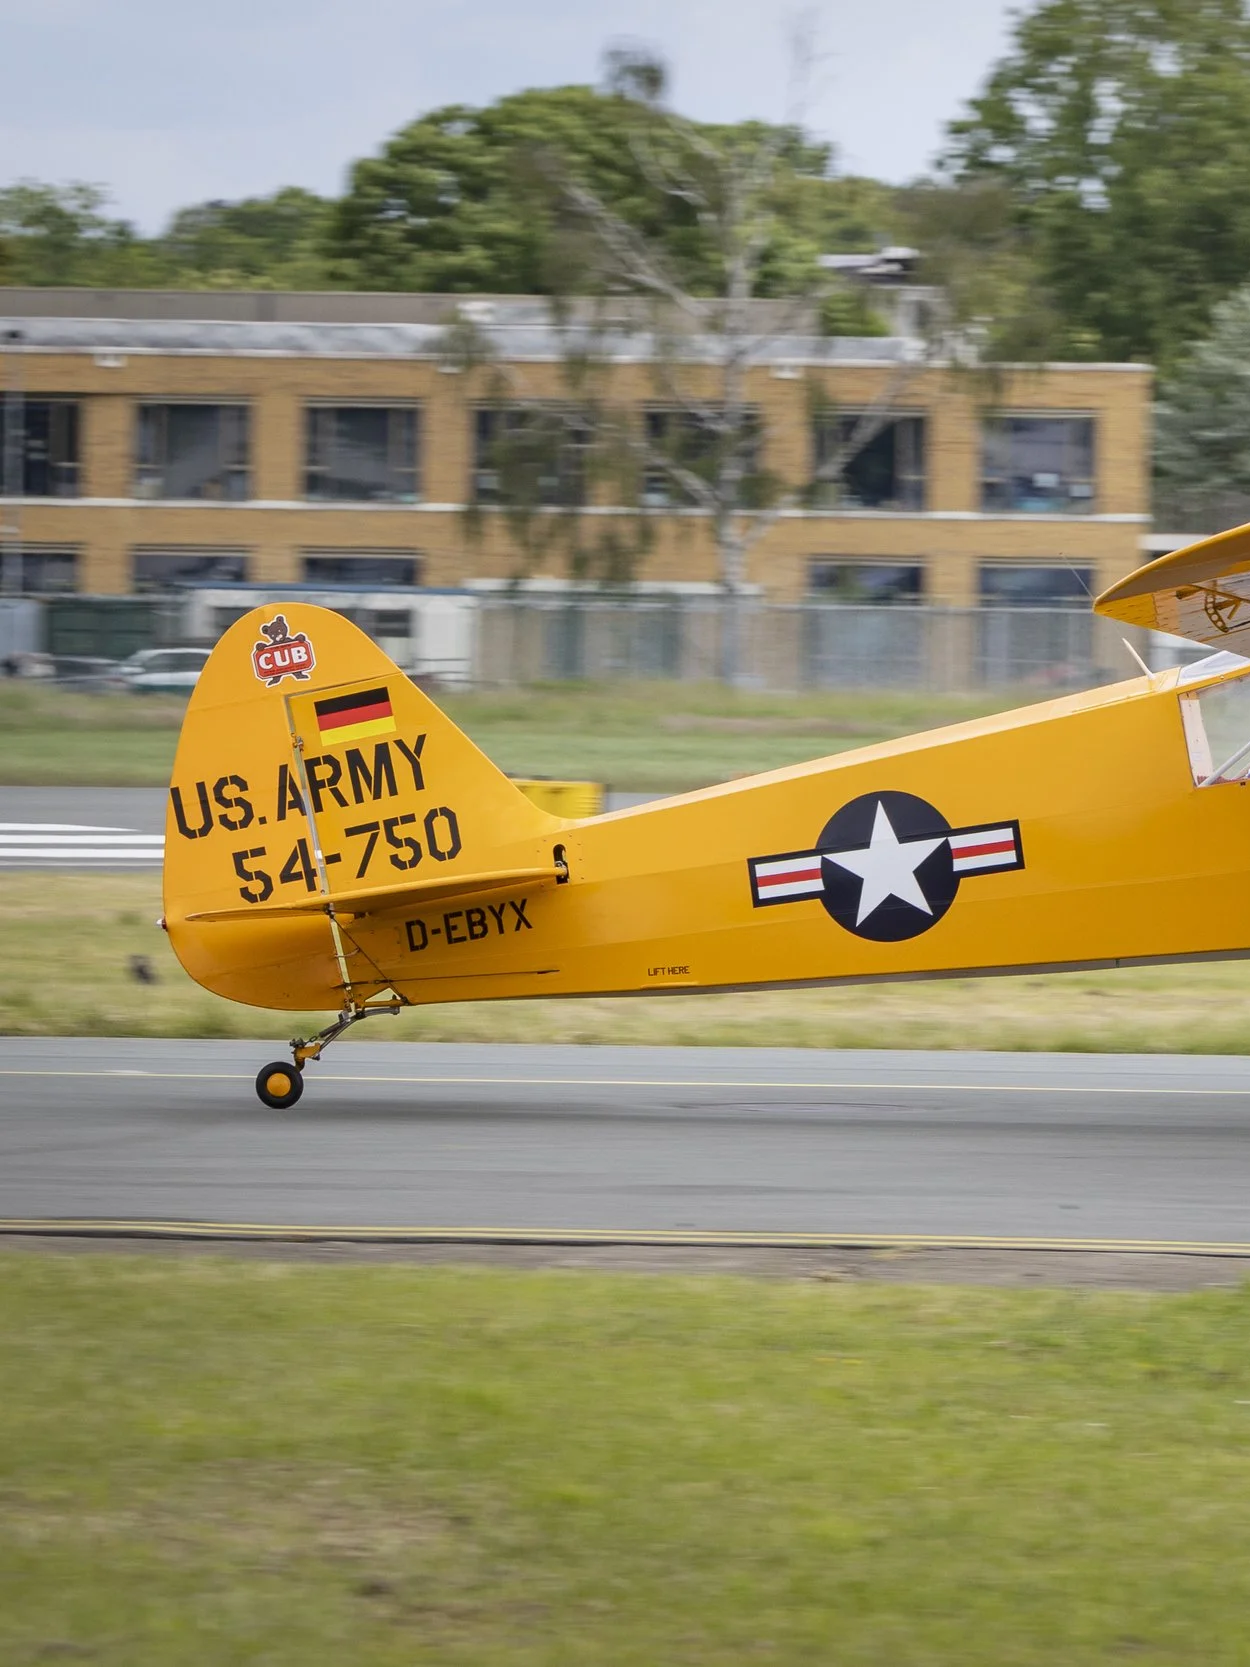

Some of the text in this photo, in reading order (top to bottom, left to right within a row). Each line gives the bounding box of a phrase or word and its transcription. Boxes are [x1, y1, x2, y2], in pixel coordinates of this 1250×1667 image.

[258, 646, 308, 670] CUB
[277, 733, 427, 822] ARMY
[232, 806, 462, 904] 54-750
[405, 898, 533, 952] D-EBYX
[648, 966, 690, 976] LIFT HERE
